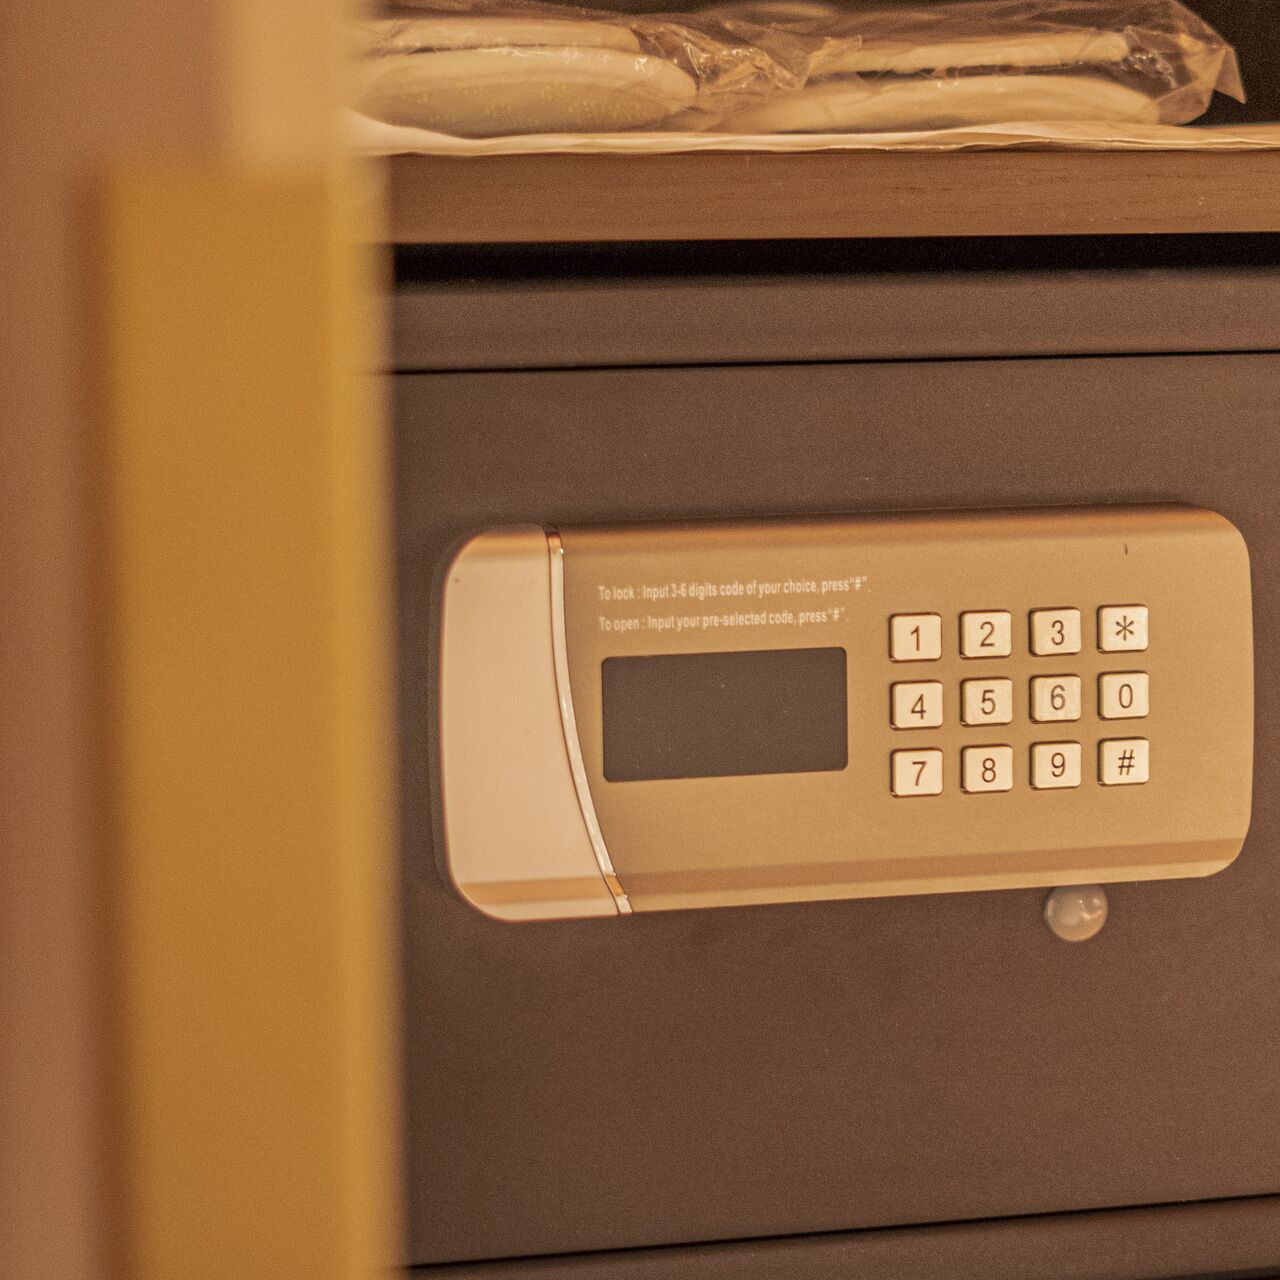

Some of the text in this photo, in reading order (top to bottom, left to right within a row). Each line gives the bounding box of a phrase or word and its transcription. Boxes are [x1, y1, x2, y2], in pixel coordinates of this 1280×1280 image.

[598, 585, 610, 600] To
[613, 585, 634, 599] lock
[643, 584, 669, 601] Input
[671, 583, 687, 598] 3-6
[690, 582, 717, 600] digits
[720, 581, 744, 595] code
[747, 580, 757, 593] of
[759, 582, 781, 598] your
[783, 578, 820, 593] choice,
[599, 617, 611, 631] To
[614, 617, 639, 633] open
[648, 615, 674, 632] Input
[677, 615, 700, 632] your
[703, 611, 766, 630] pre-selected
[769, 610, 797, 625] code,
[910, 625, 920, 652] 1
[979, 621, 996, 648] 2
[1051, 619, 1065, 646] 3
[910, 683, 1134, 720] 4 5 6 0
[911, 749, 1136, 787] 7 8 9 #
